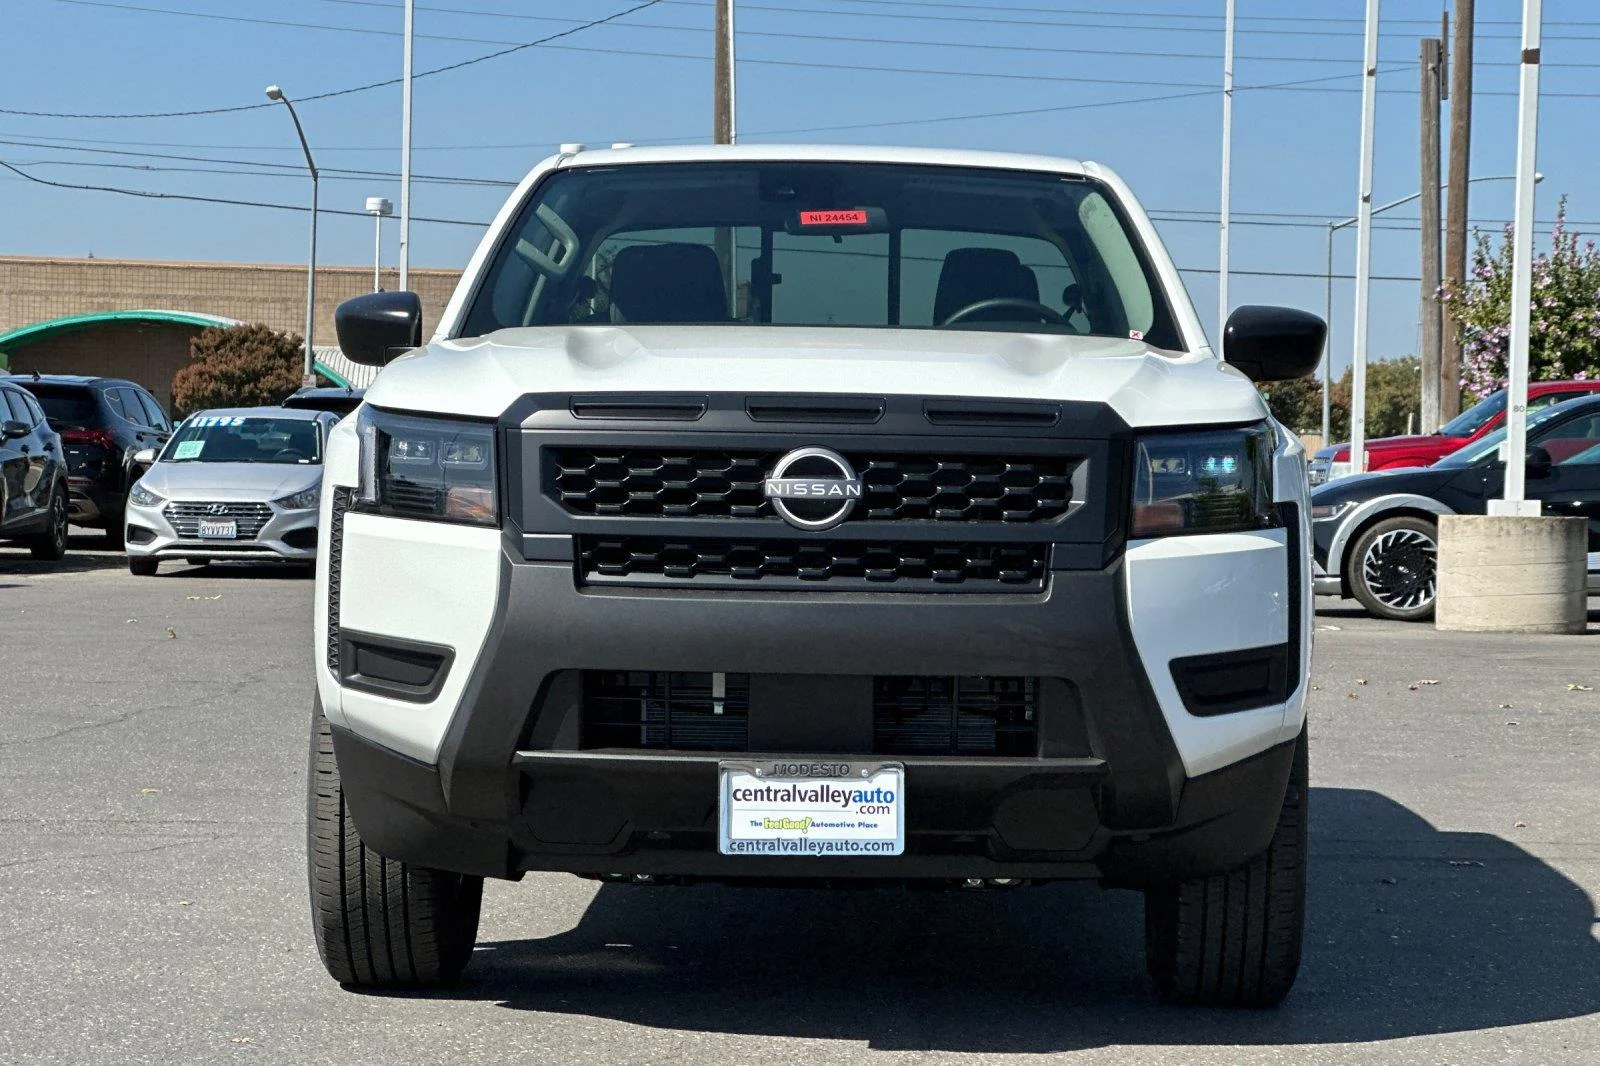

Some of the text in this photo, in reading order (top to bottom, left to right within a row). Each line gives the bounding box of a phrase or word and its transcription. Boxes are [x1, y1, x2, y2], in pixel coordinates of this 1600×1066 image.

[810, 213, 859, 222] NI 24454
[767, 483, 861, 496] NISSAN
[773, 763, 850, 777] MODESTO
[732, 784, 895, 808] centralvalleyauto
[855, 804, 891, 815] .com
[750, 820, 763, 828] The
[810, 820, 856, 829] Automotive
[857, 820, 879, 829] Place
[729, 837, 895, 856] centralvalleyauto.com
